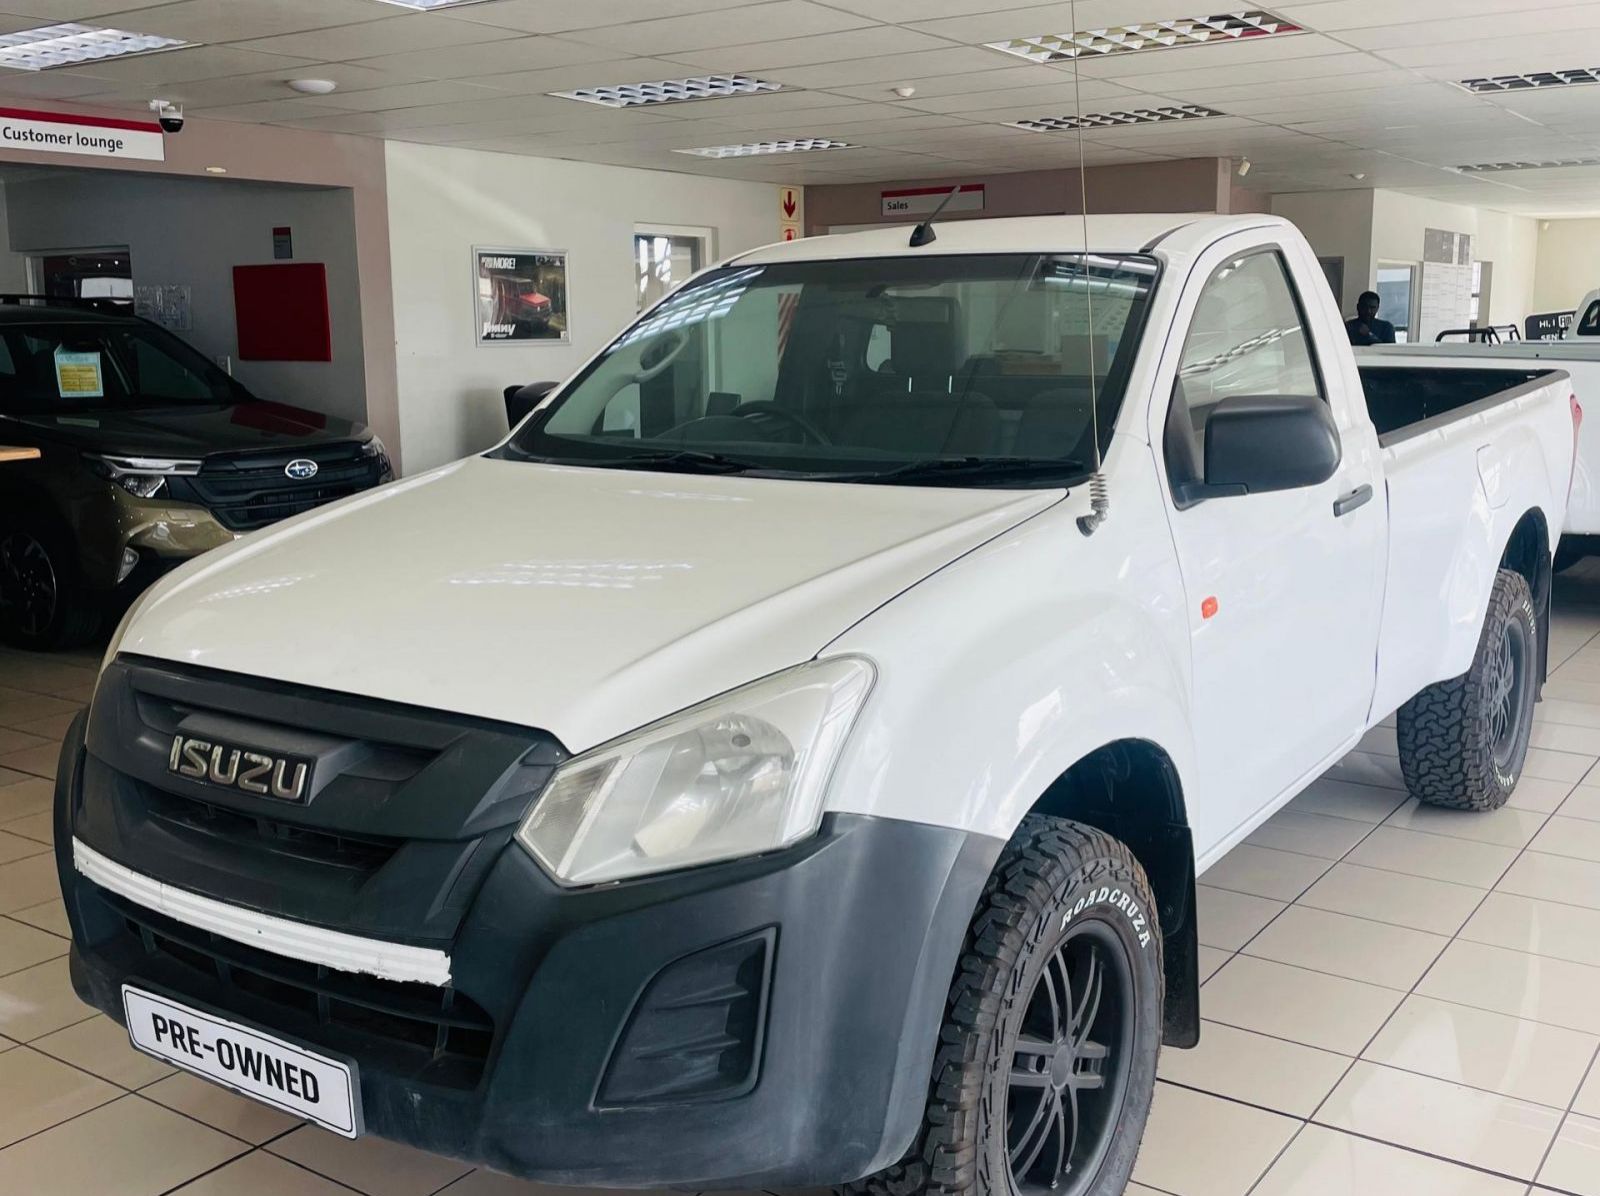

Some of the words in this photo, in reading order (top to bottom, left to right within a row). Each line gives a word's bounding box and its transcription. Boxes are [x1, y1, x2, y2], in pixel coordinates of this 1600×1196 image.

[3, 126, 73, 146] Customer
[76, 132, 123, 152] lounge
[887, 201, 909, 210] Sales
[169, 735, 307, 800] ISUZU
[1060, 887, 1150, 948] ROADCRUZA
[151, 1012, 320, 1104] PRE-OWNED
